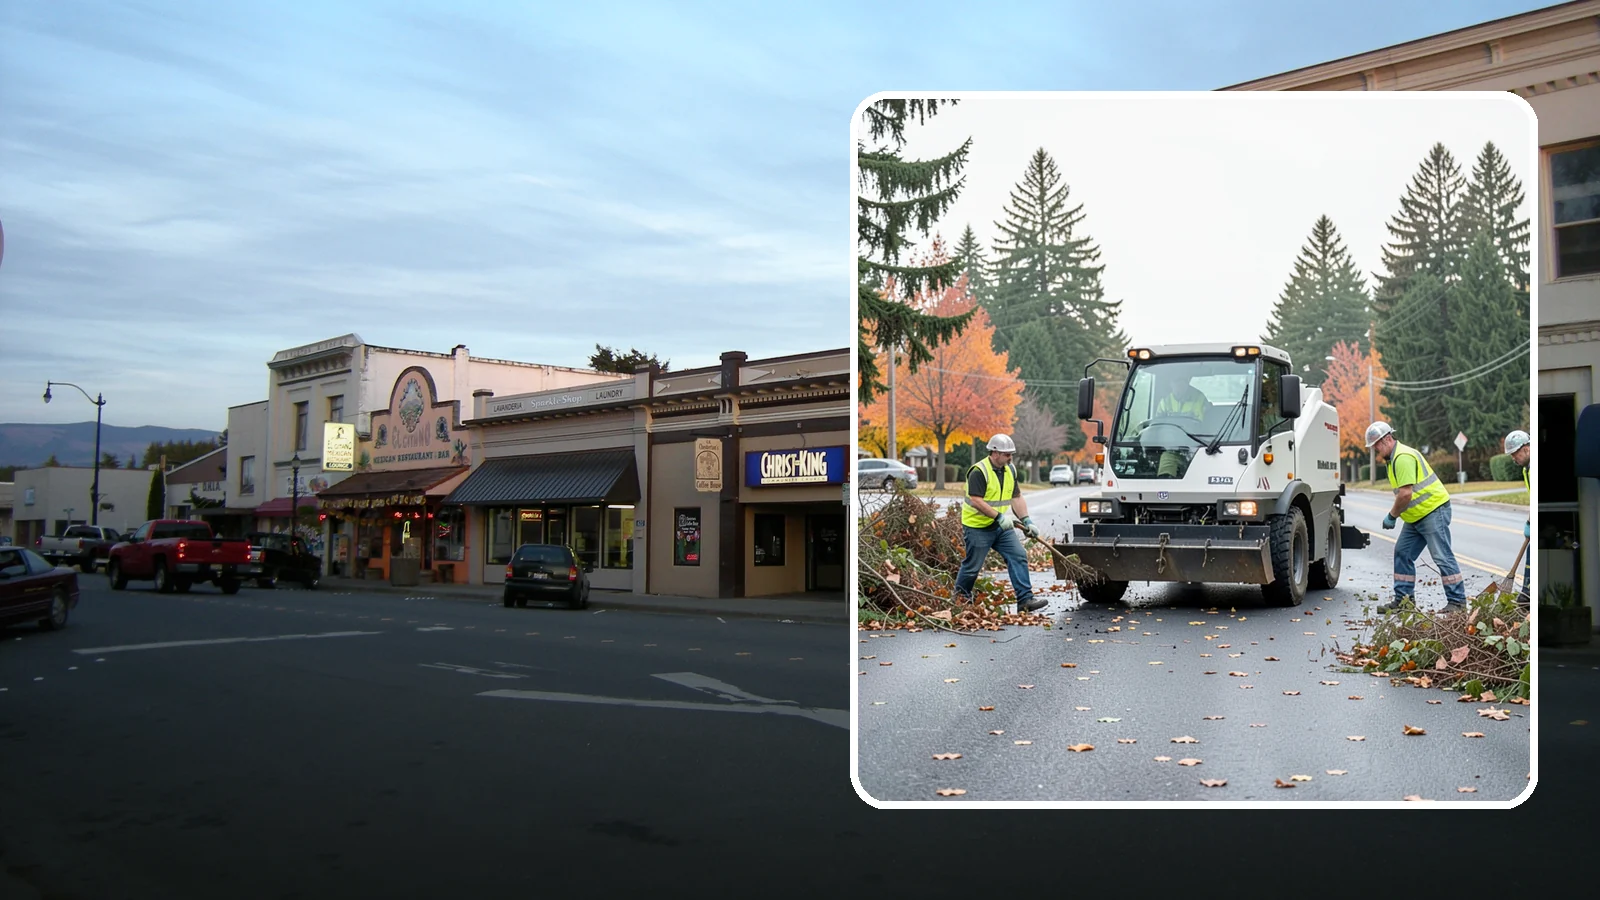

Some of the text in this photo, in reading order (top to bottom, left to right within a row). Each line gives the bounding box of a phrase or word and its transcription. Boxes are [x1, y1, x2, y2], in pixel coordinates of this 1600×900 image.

[493, 402, 523, 413] LAVANDERIA
[562, 393, 583, 405] Shop
[595, 388, 624, 400] LAUNDRY
[397, 451, 434, 462] RESTAURANT
[438, 449, 450, 459] BAR
[760, 449, 828, 478] CHRIST KING
